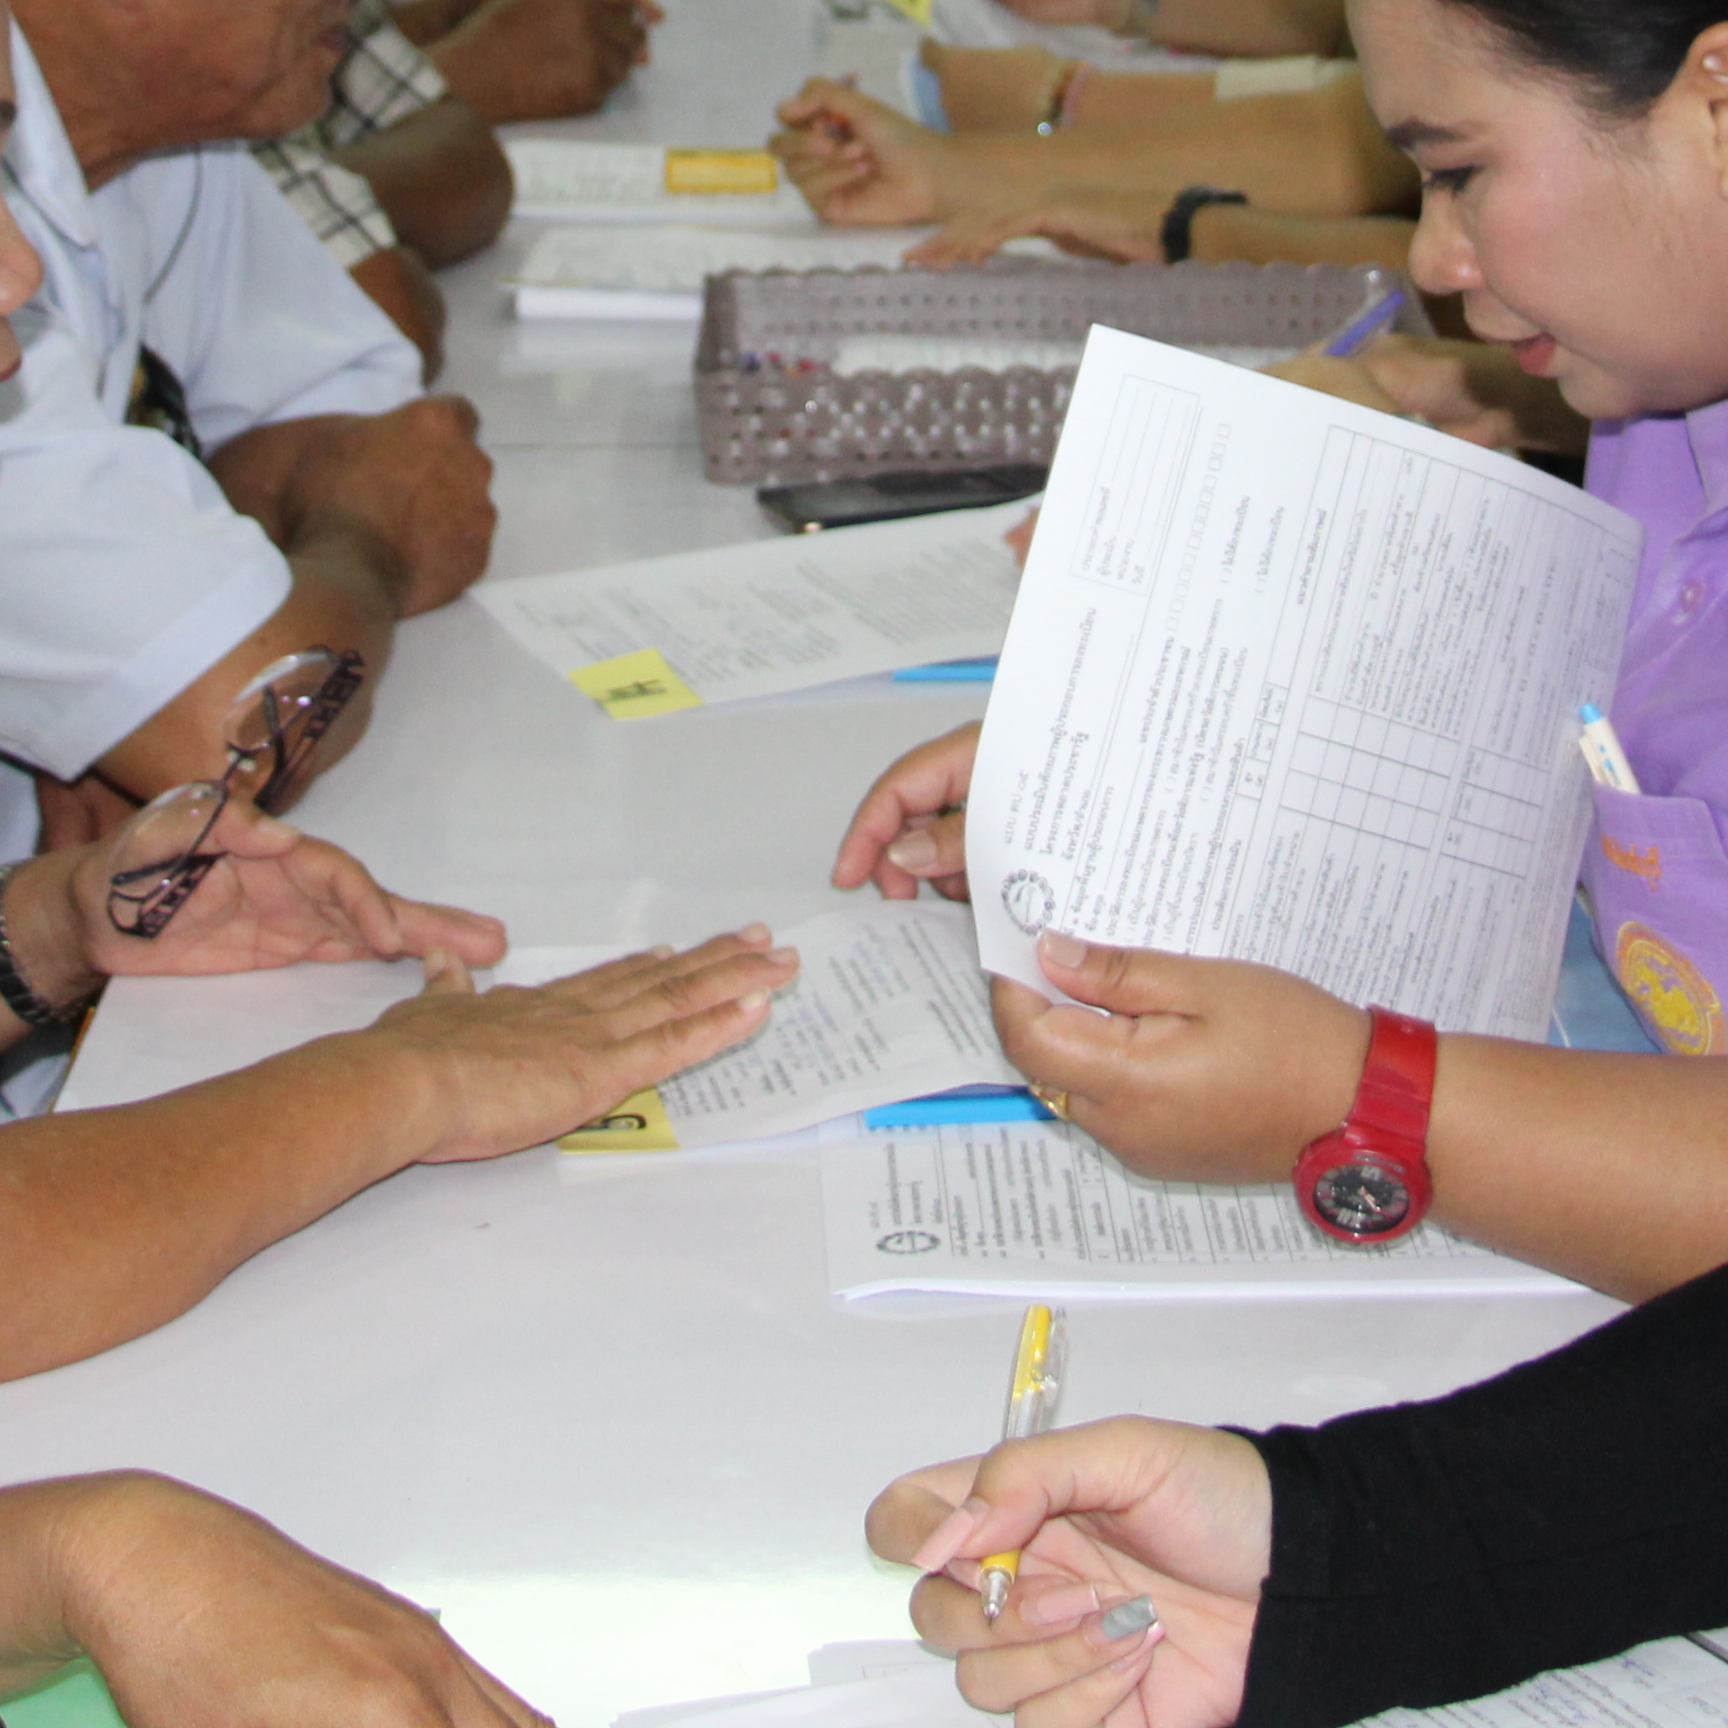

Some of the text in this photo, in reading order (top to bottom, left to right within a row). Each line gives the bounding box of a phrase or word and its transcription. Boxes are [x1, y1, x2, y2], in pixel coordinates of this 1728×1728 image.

[1038, 729, 1090, 857] โครงการตลาดประชารัฐ
